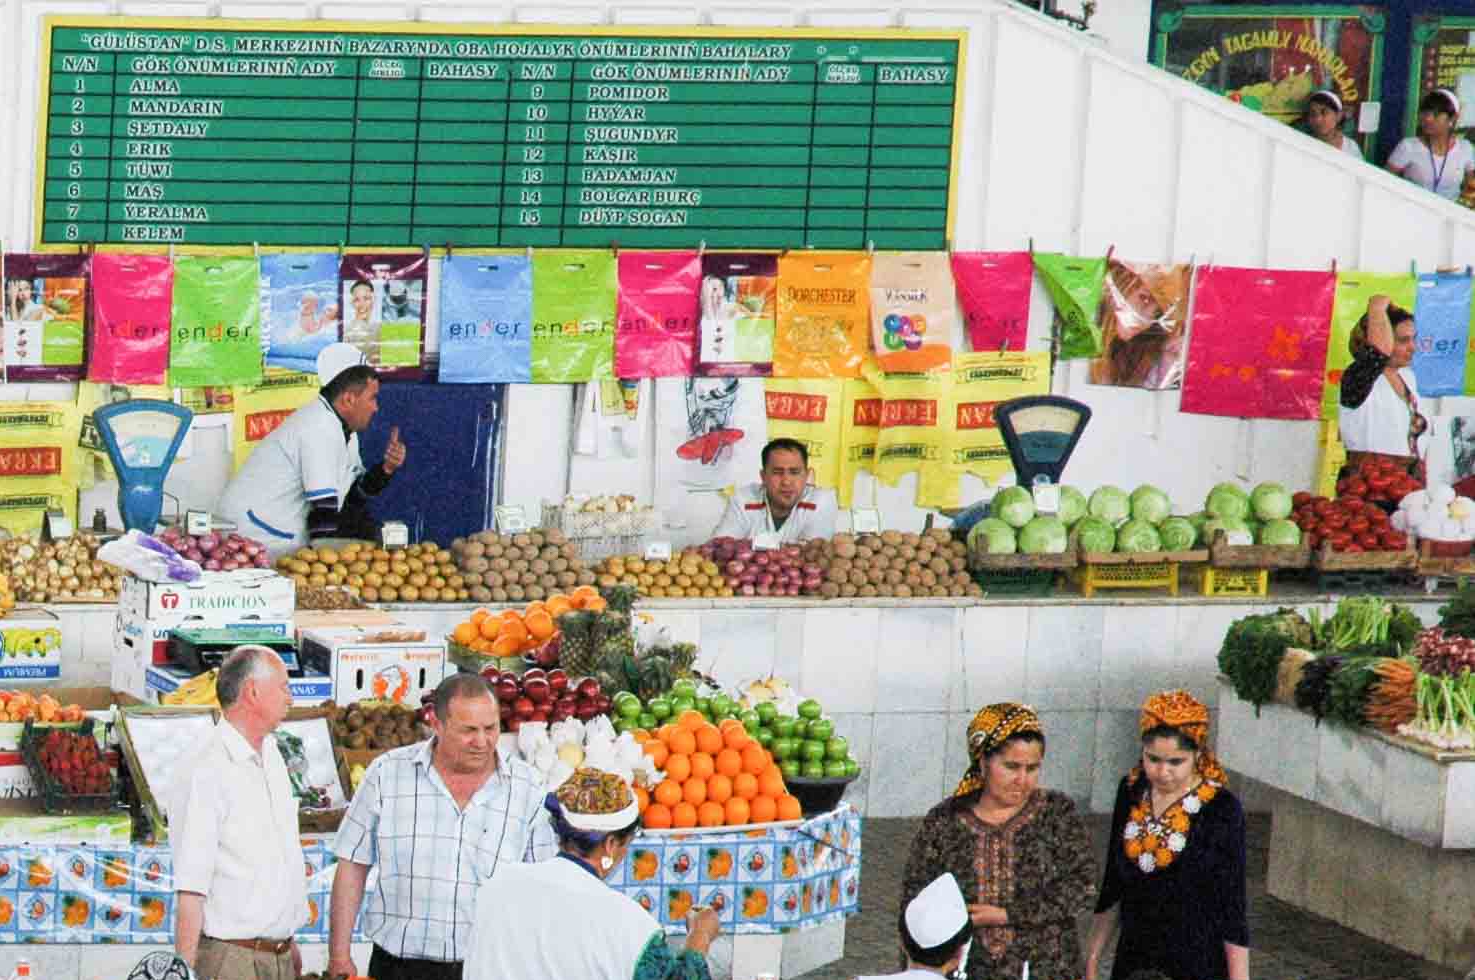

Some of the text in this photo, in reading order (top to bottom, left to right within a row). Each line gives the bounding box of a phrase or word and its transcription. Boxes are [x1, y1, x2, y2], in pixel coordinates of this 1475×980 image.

[348, 39, 451, 57] BAZARYNDA
[455, 42, 489, 57] OBA
[493, 41, 574, 58] HOJALYK
[701, 45, 792, 60] BAHALARY
[130, 57, 170, 74] GÖK
[300, 61, 336, 76] ADY
[428, 62, 499, 79] BAHASY
[590, 64, 631, 80] GÖK
[755, 67, 791, 81] ADY
[879, 67, 949, 83] BAHASY
[76, 78, 181, 95] 1 ALMA
[532, 84, 670, 101] 9 POMIDOR
[72, 99, 224, 116] 2 MANDARIN
[527, 106, 548, 121] 10
[71, 120, 84, 135] 3
[525, 127, 545, 142] 11
[70, 140, 172, 157] 4 ERIK
[524, 148, 544, 162] 12
[69, 161, 172, 178] 5 TÜWI
[522, 167, 677, 184] 13 BADAMJAN
[68, 183, 80, 199] 6
[520, 190, 542, 205] 14
[581, 188, 651, 204] BOLGAR
[67, 204, 79, 219] 7
[519, 210, 540, 225] 15
[628, 210, 687, 226] SOGAN
[66, 224, 185, 241] 8 KELEM
[786, 286, 857, 305] DORCHESTER
[177, 321, 254, 340] ender
[188, 593, 267, 610] TRADICION
